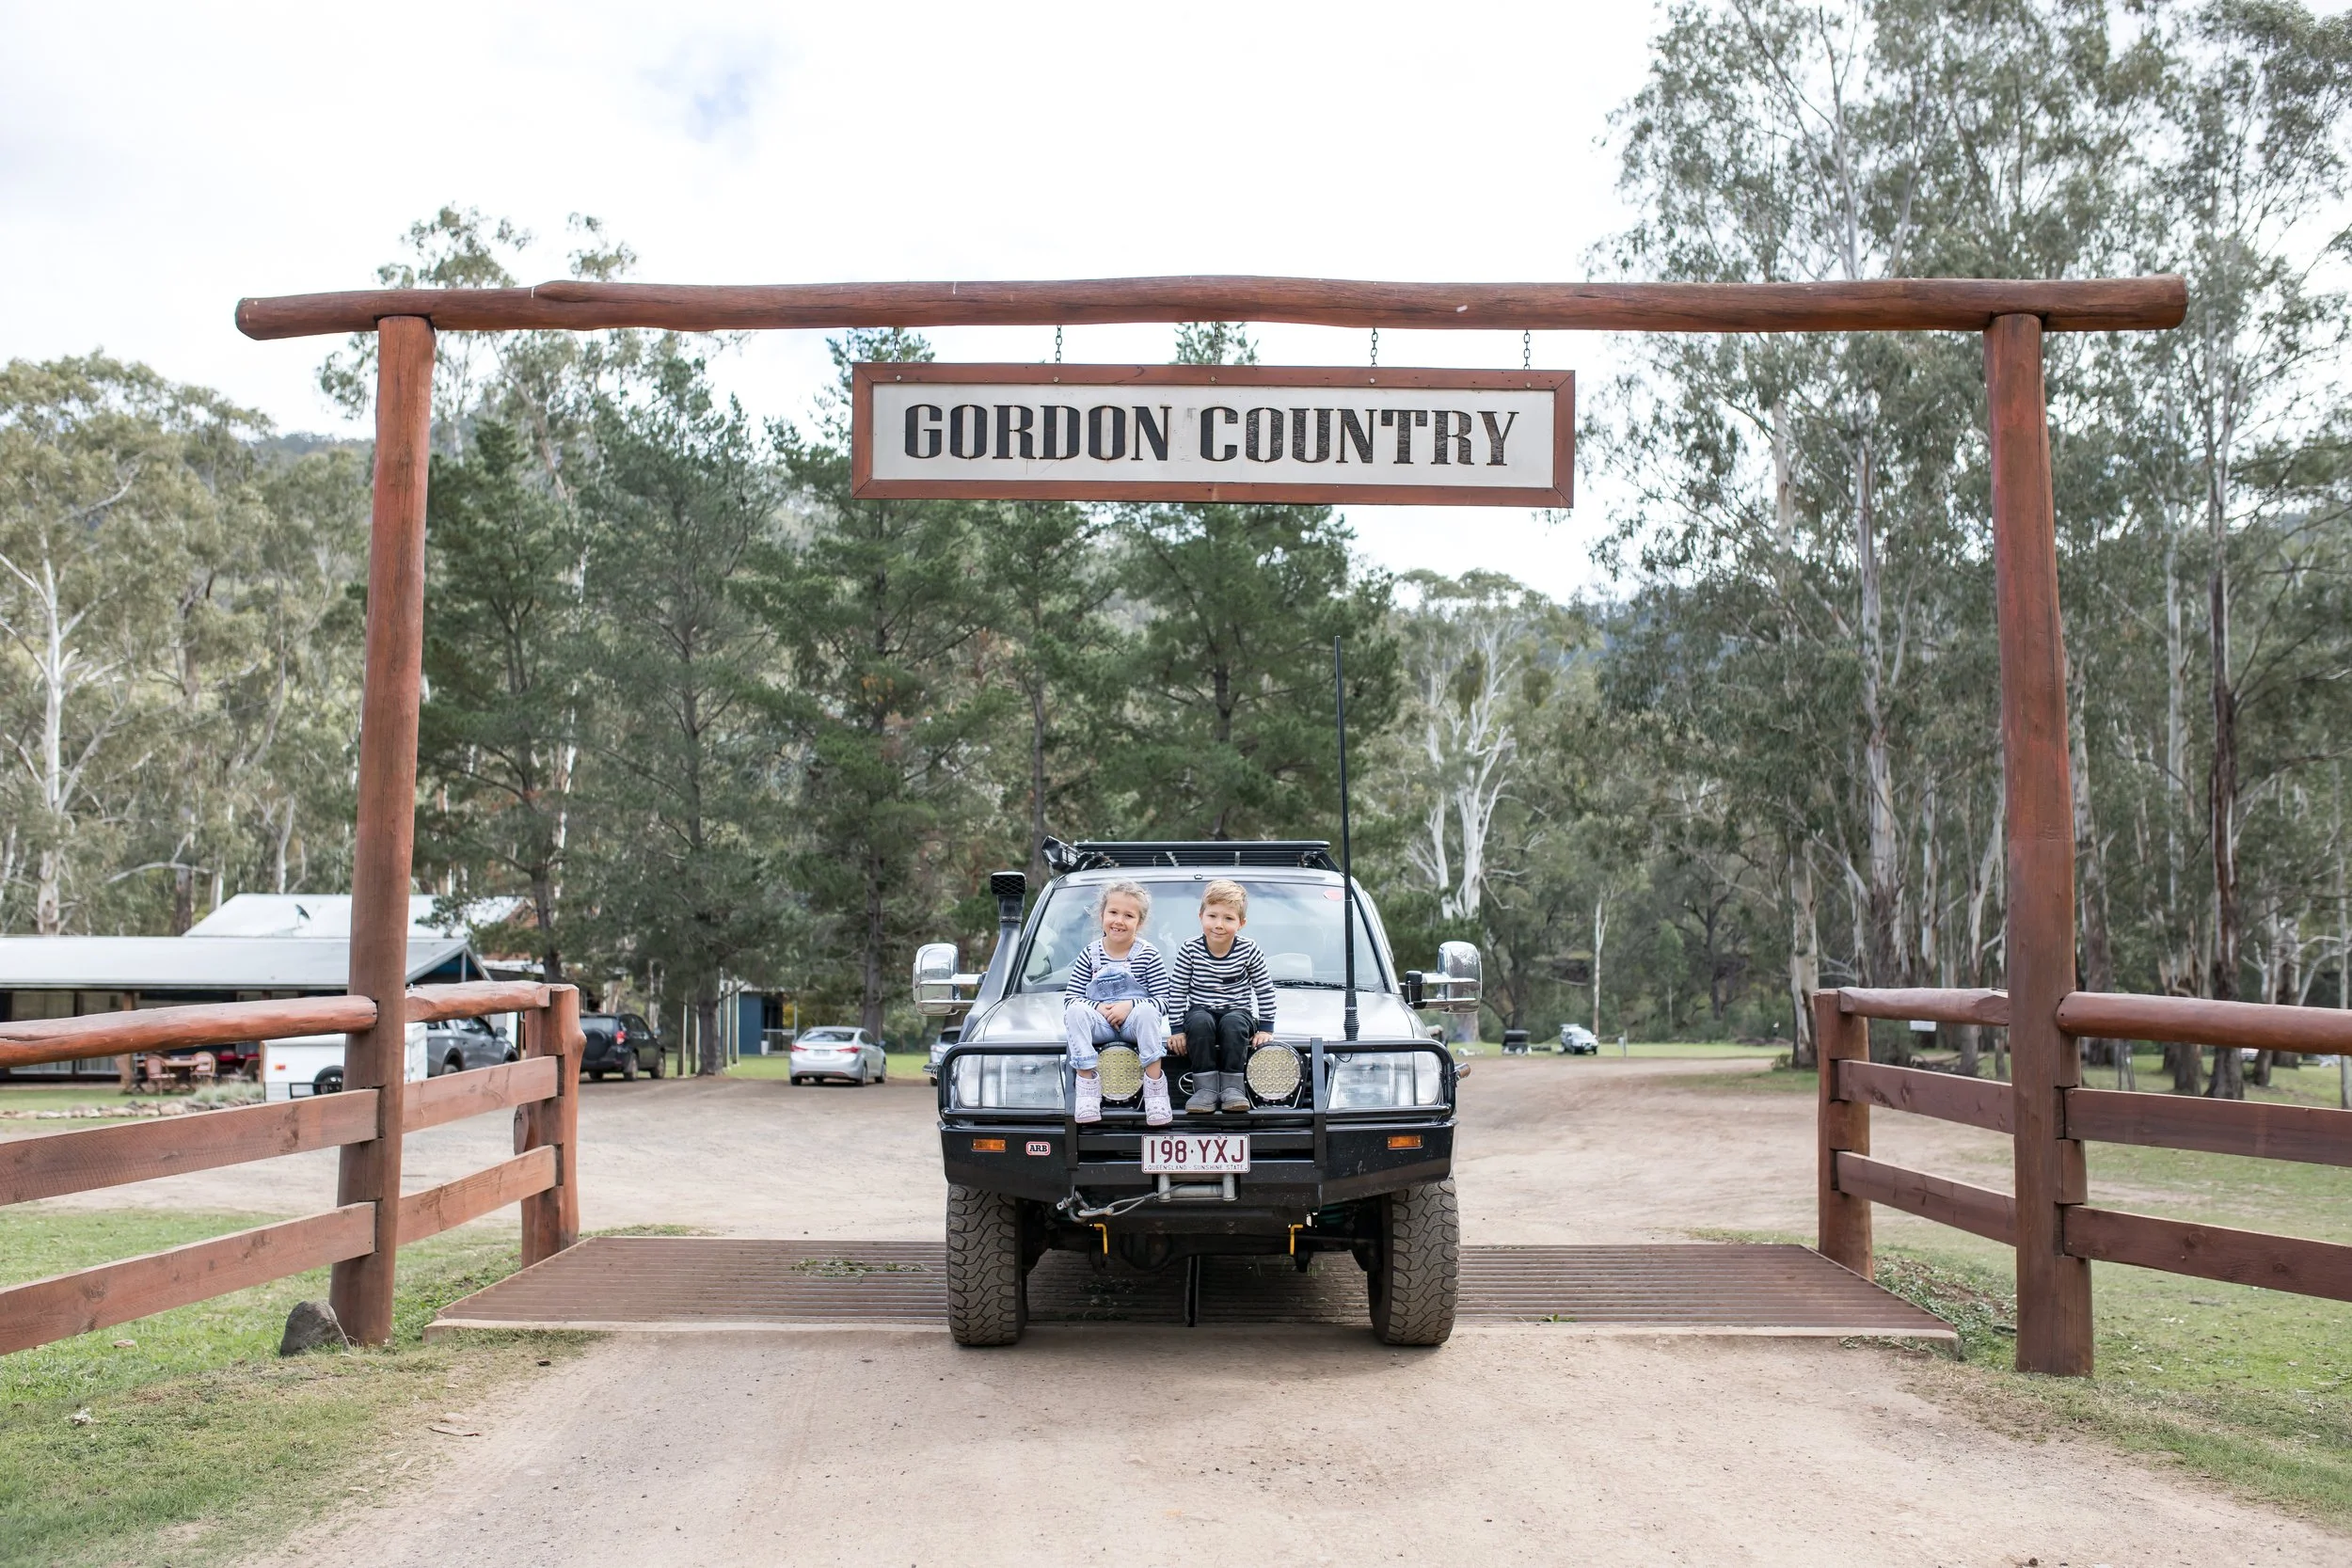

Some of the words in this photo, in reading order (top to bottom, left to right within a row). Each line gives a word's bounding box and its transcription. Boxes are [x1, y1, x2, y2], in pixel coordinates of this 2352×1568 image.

[905, 404, 1171, 462] GORDON
[1200, 406, 1519, 467] COUNTRY
[1029, 1144, 1048, 1152] ARB
[1151, 1140, 1187, 1163] 198
[1197, 1140, 1244, 1163] YXJ
